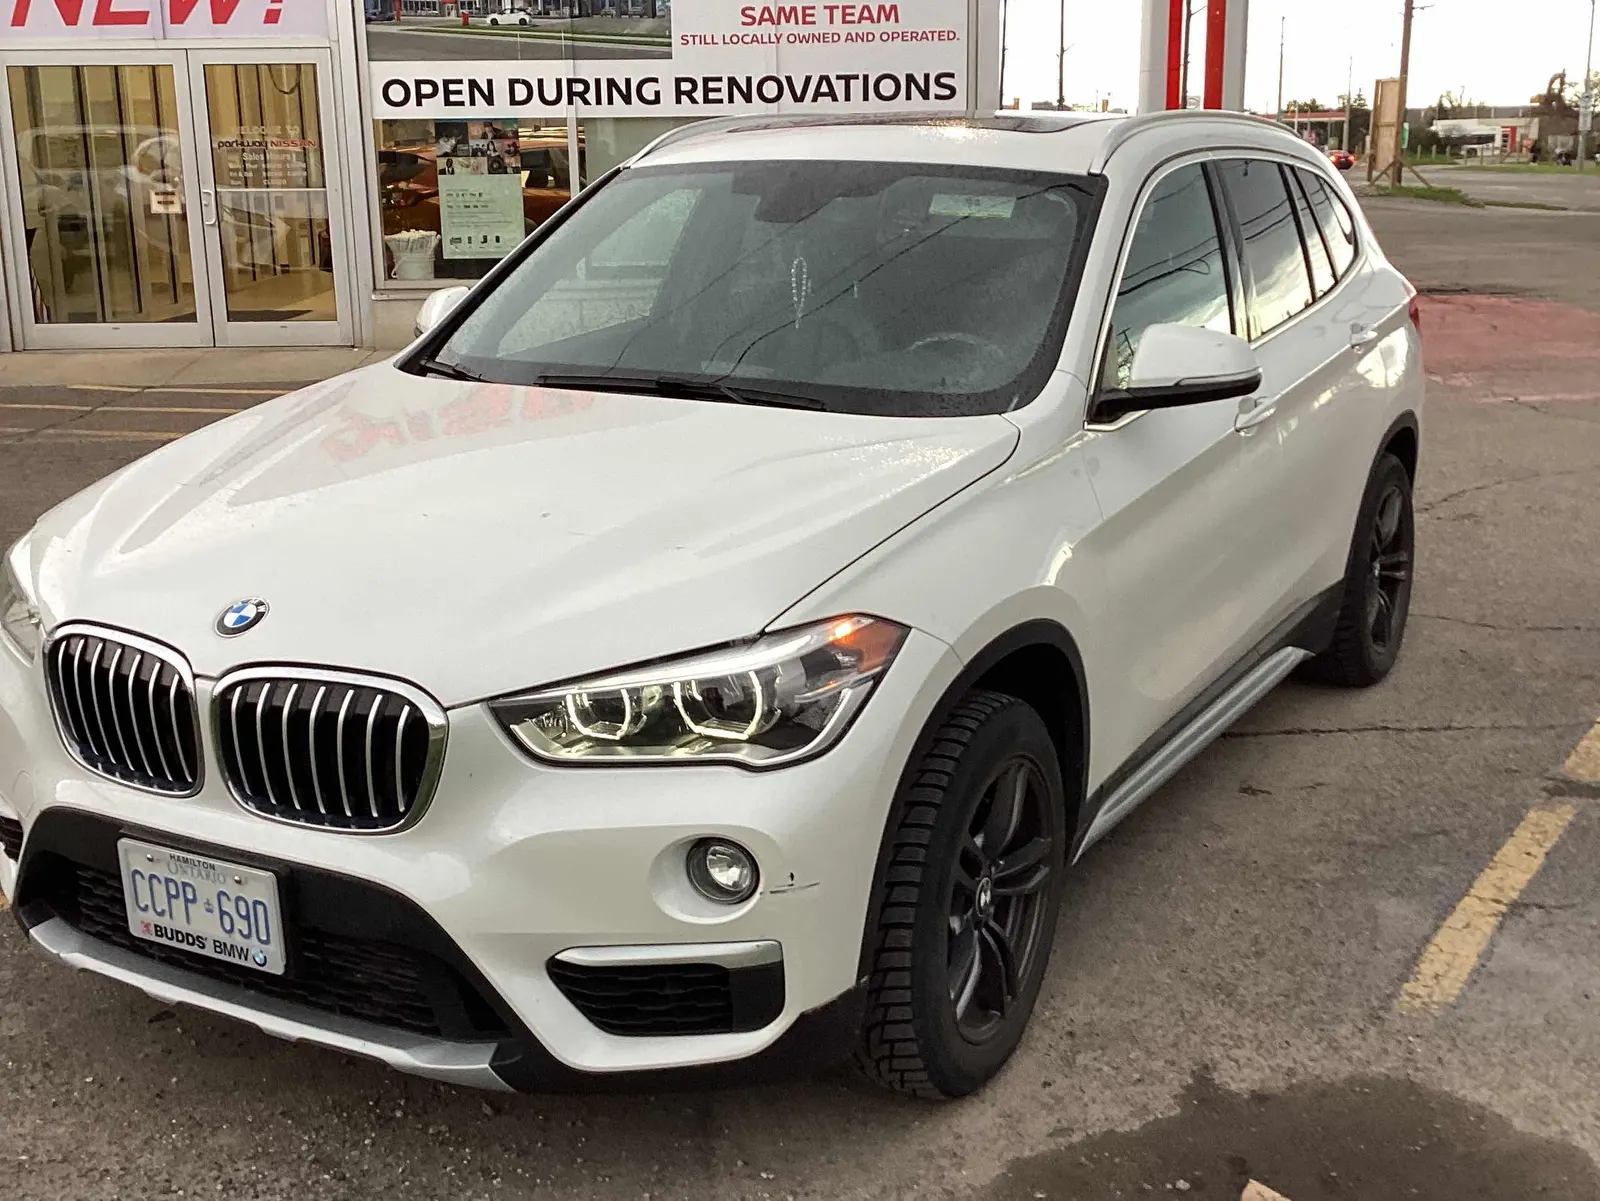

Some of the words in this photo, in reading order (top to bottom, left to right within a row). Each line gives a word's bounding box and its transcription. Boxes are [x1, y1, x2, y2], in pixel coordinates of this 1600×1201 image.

[740, 6, 817, 26] SAME
[823, 4, 900, 25] TEAM
[680, 34, 719, 46] STILL
[722, 33, 783, 45] LOCALLY
[786, 32, 841, 44] OWNED
[845, 31, 876, 43] AND
[879, 30, 961, 43] OPERATED.
[381, 78, 495, 108] OPEN
[507, 76, 662, 107] DURING
[673, 71, 958, 105] RENOVATIONS
[217, 139, 268, 150] parkway
[270, 139, 317, 148] NISSAN
[169, 853, 216, 872] HAMILTON
[131, 868, 198, 926] CCPP
[216, 889, 271, 946] 690
[212, 939, 249, 962] BMW
